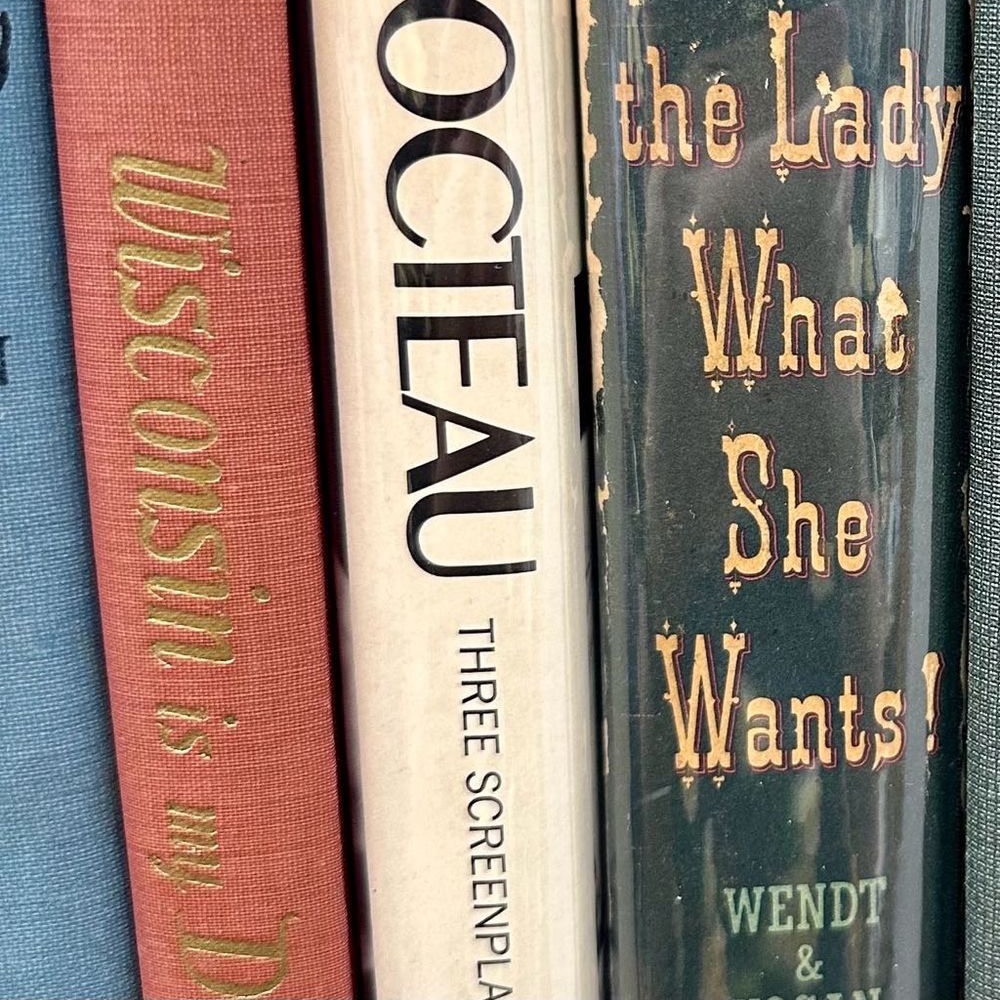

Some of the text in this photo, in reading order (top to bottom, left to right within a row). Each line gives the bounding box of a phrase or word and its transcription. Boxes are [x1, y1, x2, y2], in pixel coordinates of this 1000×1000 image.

[613, 5, 965, 196] the Lady
[682, 218, 918, 380] What
[110, 144, 271, 669] Wisconsin
[721, 428, 876, 580] She
[155, 701, 239, 762] is
[458, 618, 501, 757] THREE
[654, 625, 948, 773] Wants!
[150, 803, 223, 893] my
[724, 876, 888, 934] WENDT
[795, 944, 824, 982] &
